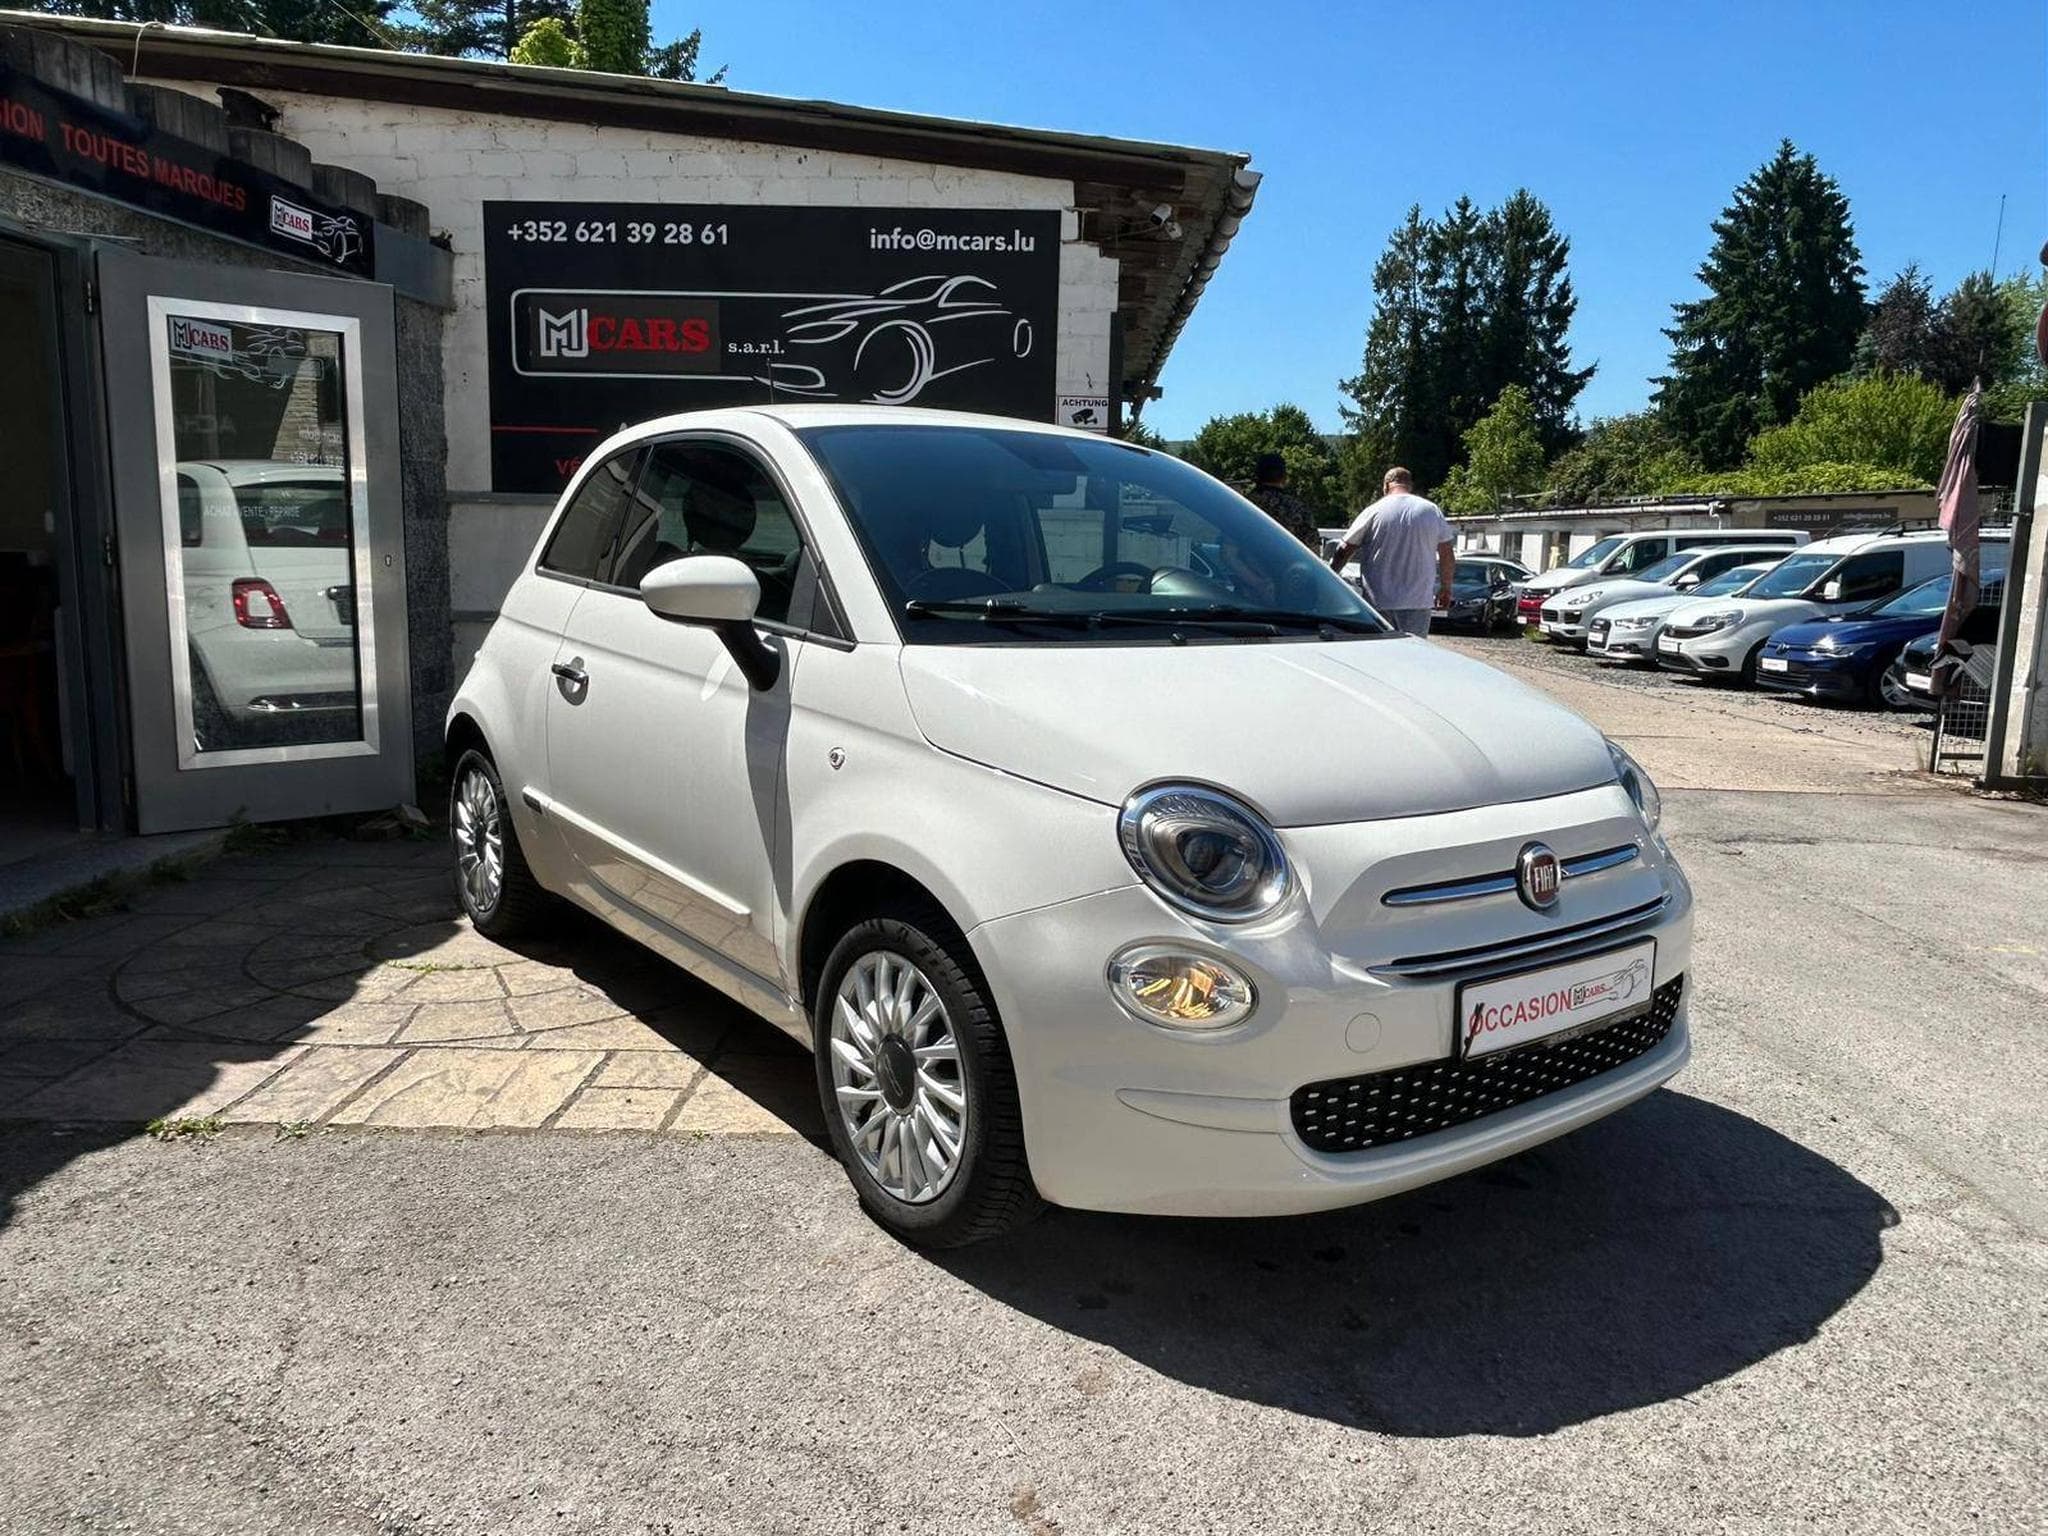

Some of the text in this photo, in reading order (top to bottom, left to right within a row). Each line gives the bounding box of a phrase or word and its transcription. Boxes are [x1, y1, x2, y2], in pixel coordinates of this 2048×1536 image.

[60, 122, 149, 178] TOUTES
[153, 156, 247, 211] MARQUES
[507, 220, 729, 245] +352 621 39 28 61
[869, 226, 1035, 251] info@mcars.lu
[1062, 399, 1108, 407] ACHTUNG
[1534, 863, 1555, 893] FIAT
[1469, 988, 1572, 1037] OCCASION
